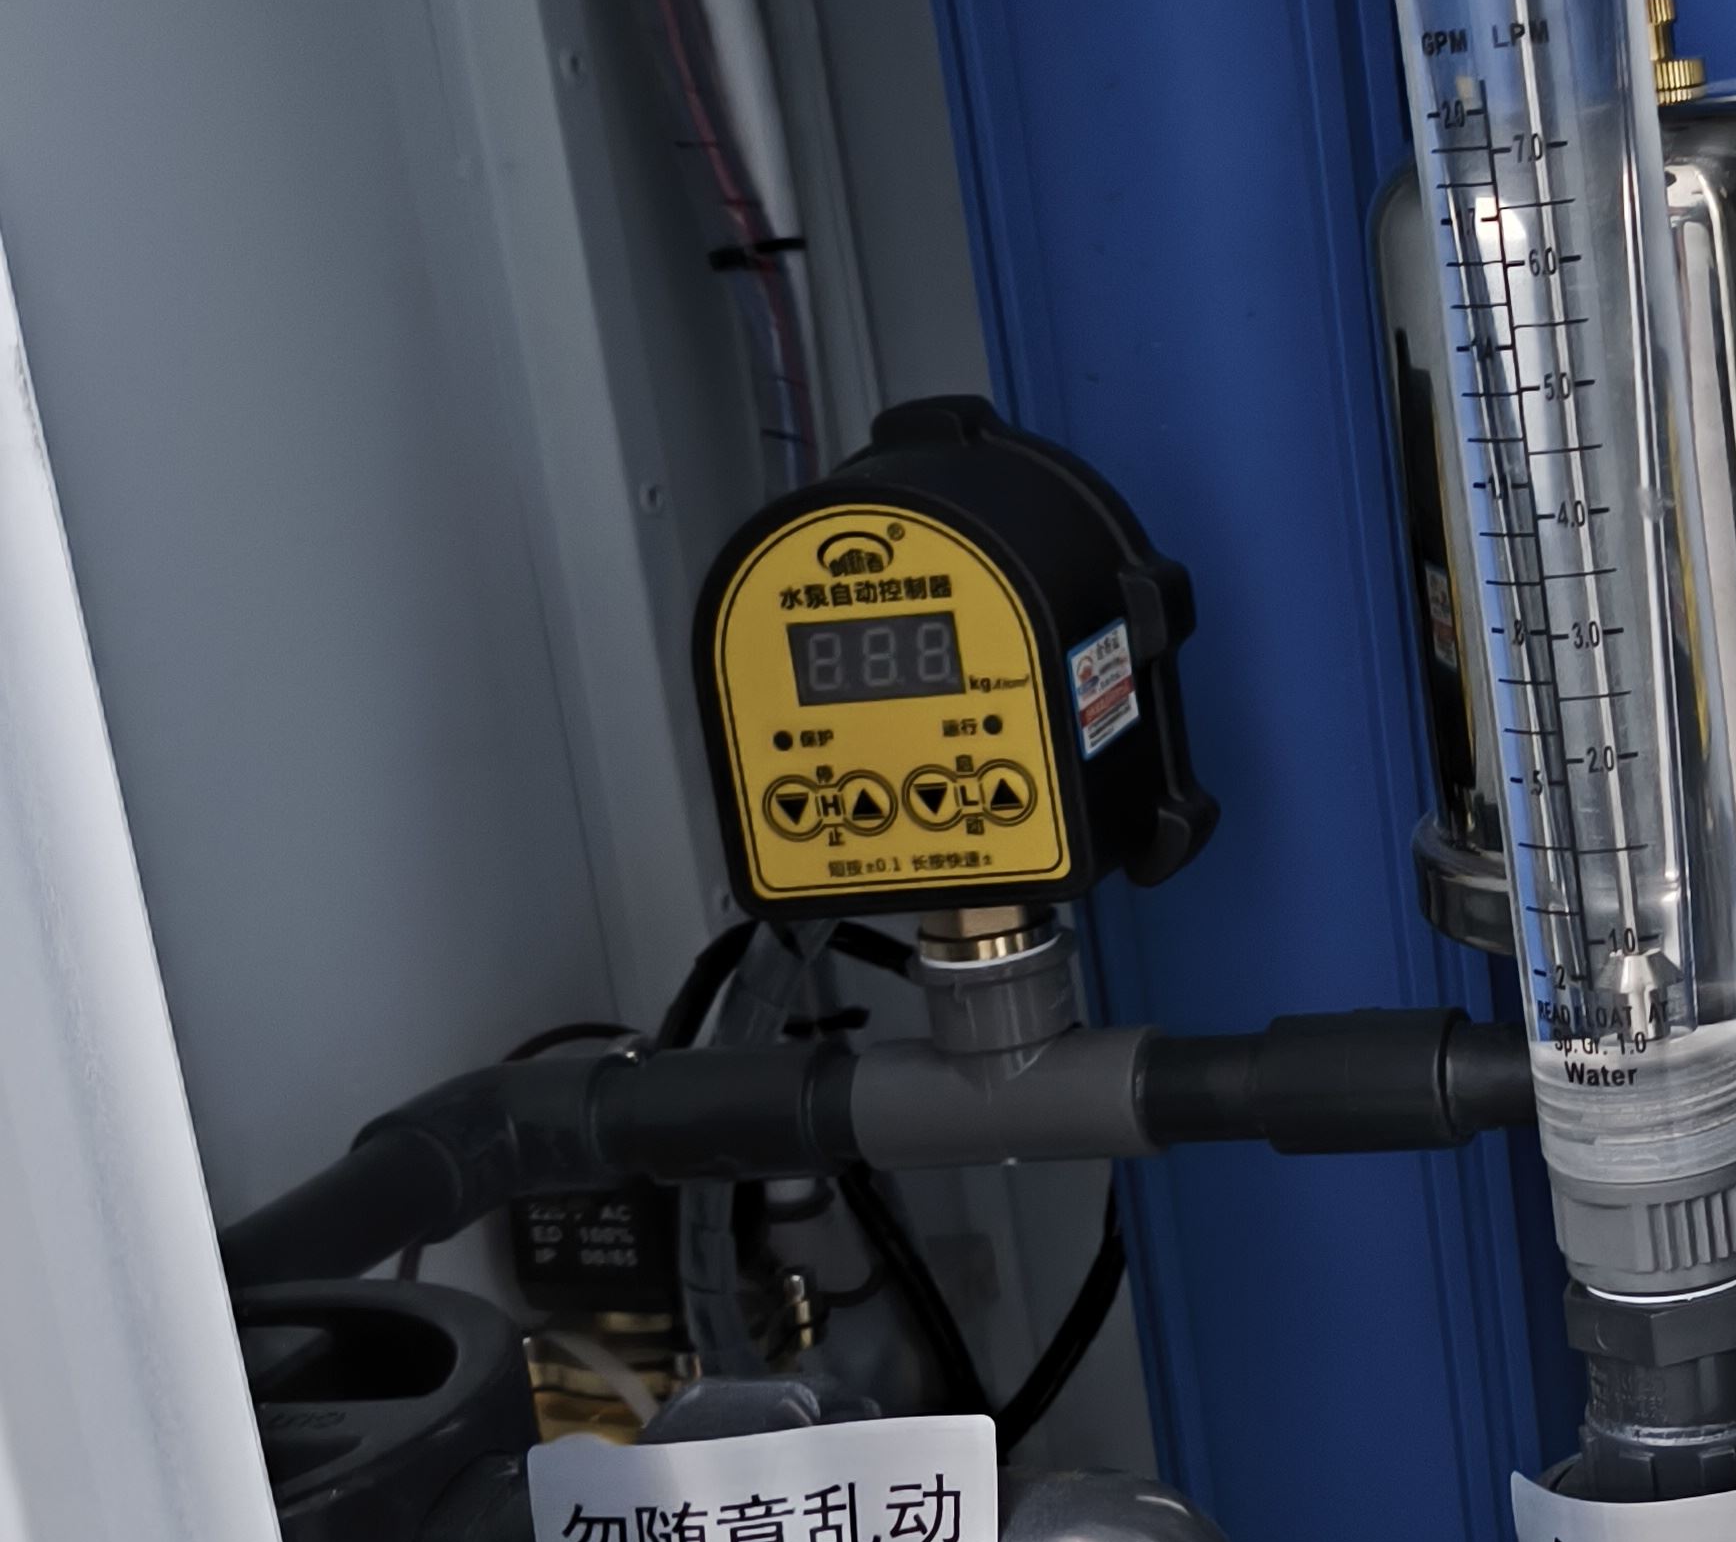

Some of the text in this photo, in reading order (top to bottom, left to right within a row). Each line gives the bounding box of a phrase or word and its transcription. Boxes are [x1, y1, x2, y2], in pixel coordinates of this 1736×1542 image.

[1422, 28, 1468, 57] GPM
[1528, 247, 1557, 277] 6.0
[1557, 500, 1586, 528] 4.0
[779, 574, 952, 610] 水泵自动控制器
[1572, 621, 1600, 649] 3.0
[1586, 746, 1615, 774] 2.0
[1564, 1061, 1638, 1087] Water
